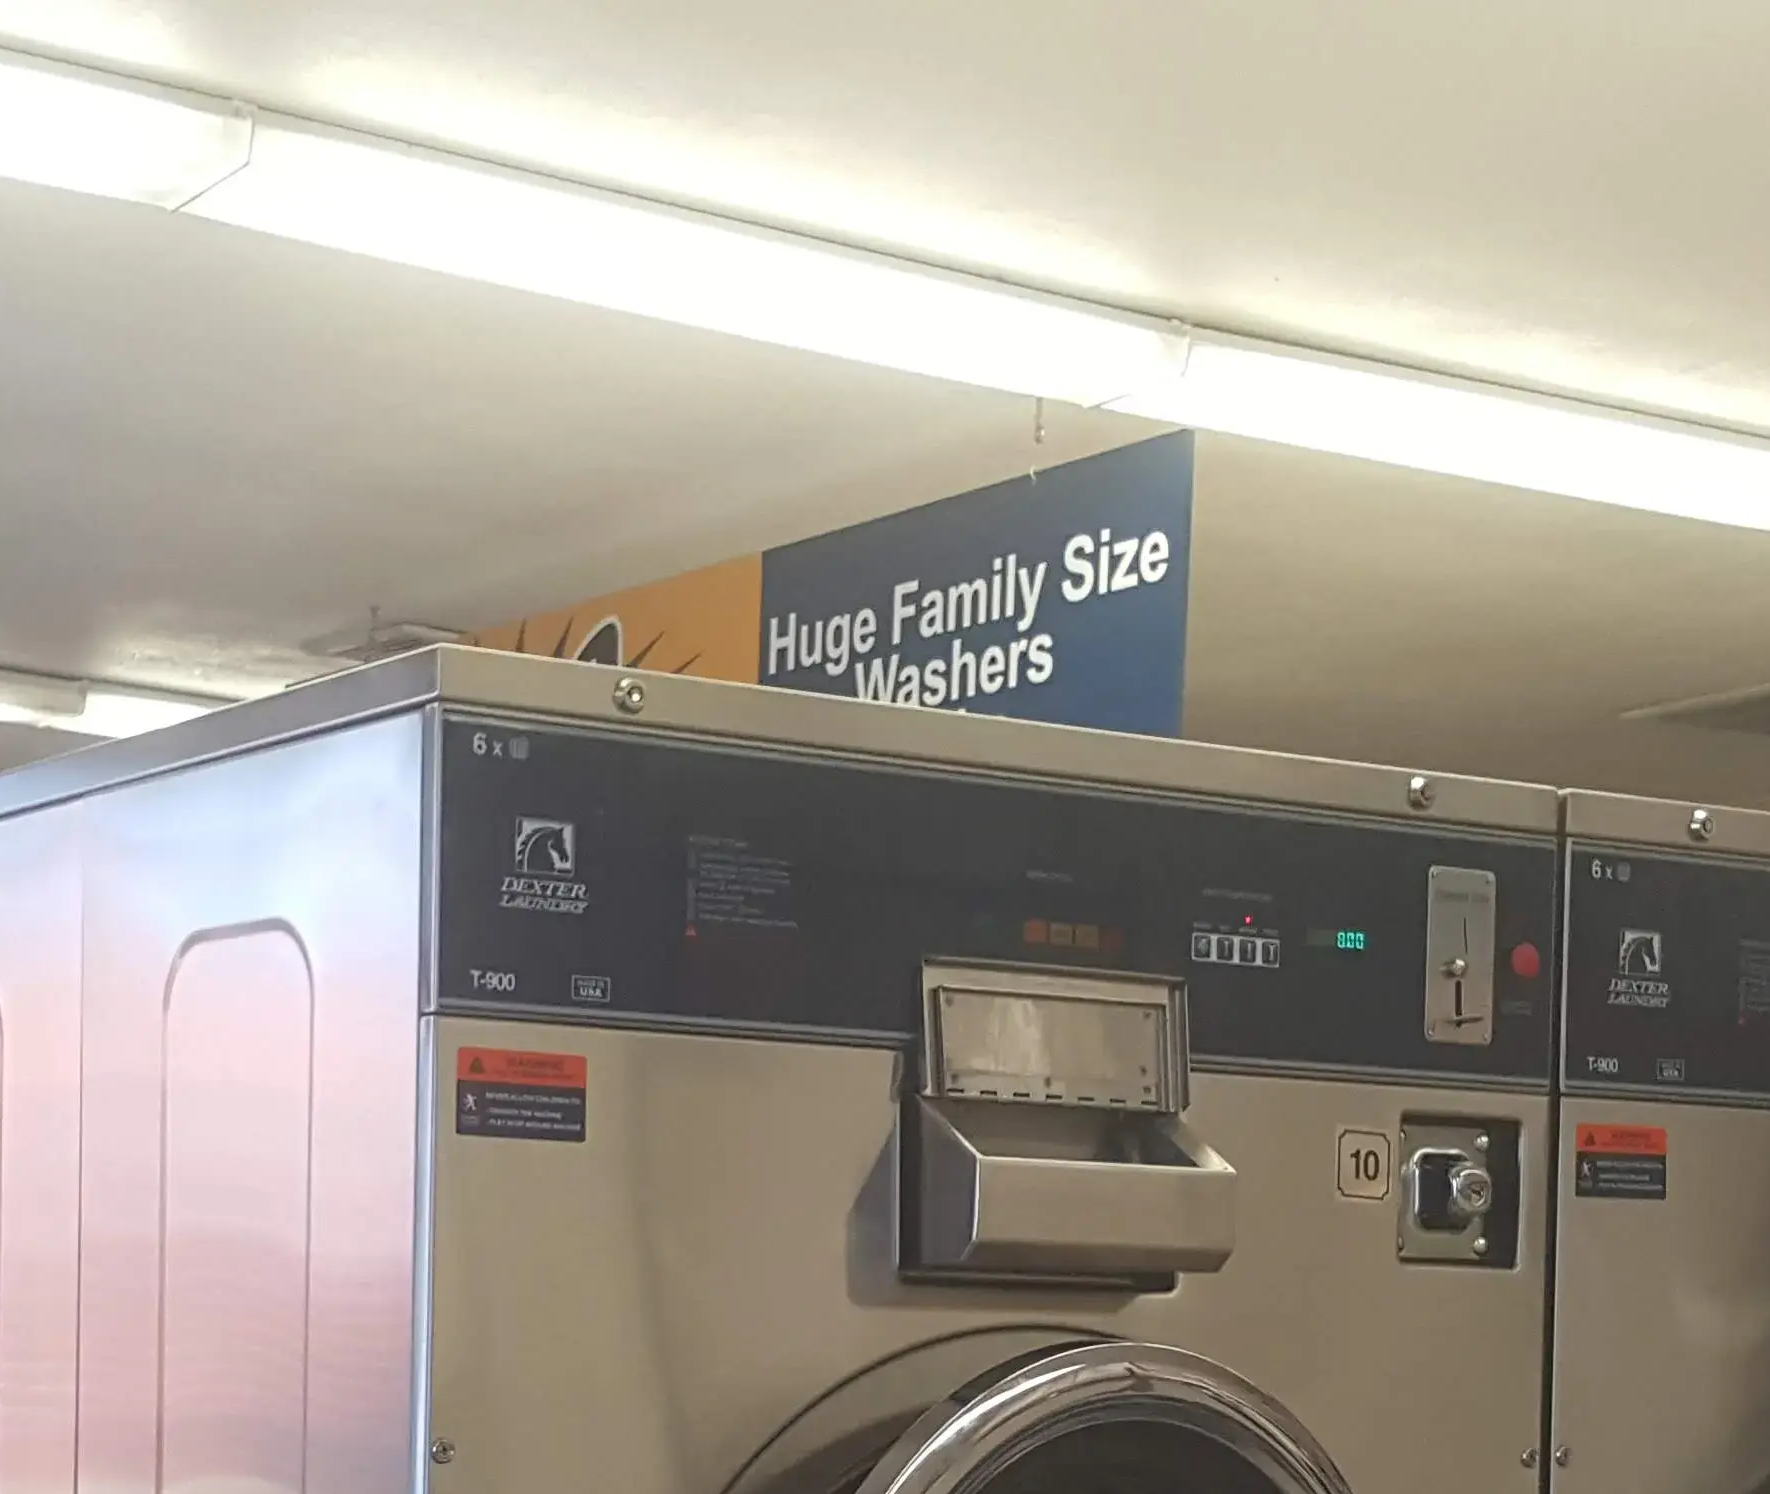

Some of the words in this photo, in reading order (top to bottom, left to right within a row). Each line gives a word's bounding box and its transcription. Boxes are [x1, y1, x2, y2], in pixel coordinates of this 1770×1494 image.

[767, 606, 877, 677] Huge
[892, 553, 1048, 645] Family
[1061, 527, 1169, 603] Size
[854, 632, 1054, 708] Washers
[501, 876, 587, 899] DEXTER
[470, 969, 516, 992] T-900
[1587, 1056, 1619, 1074] T-900
[1350, 1148, 1380, 1181] 10
